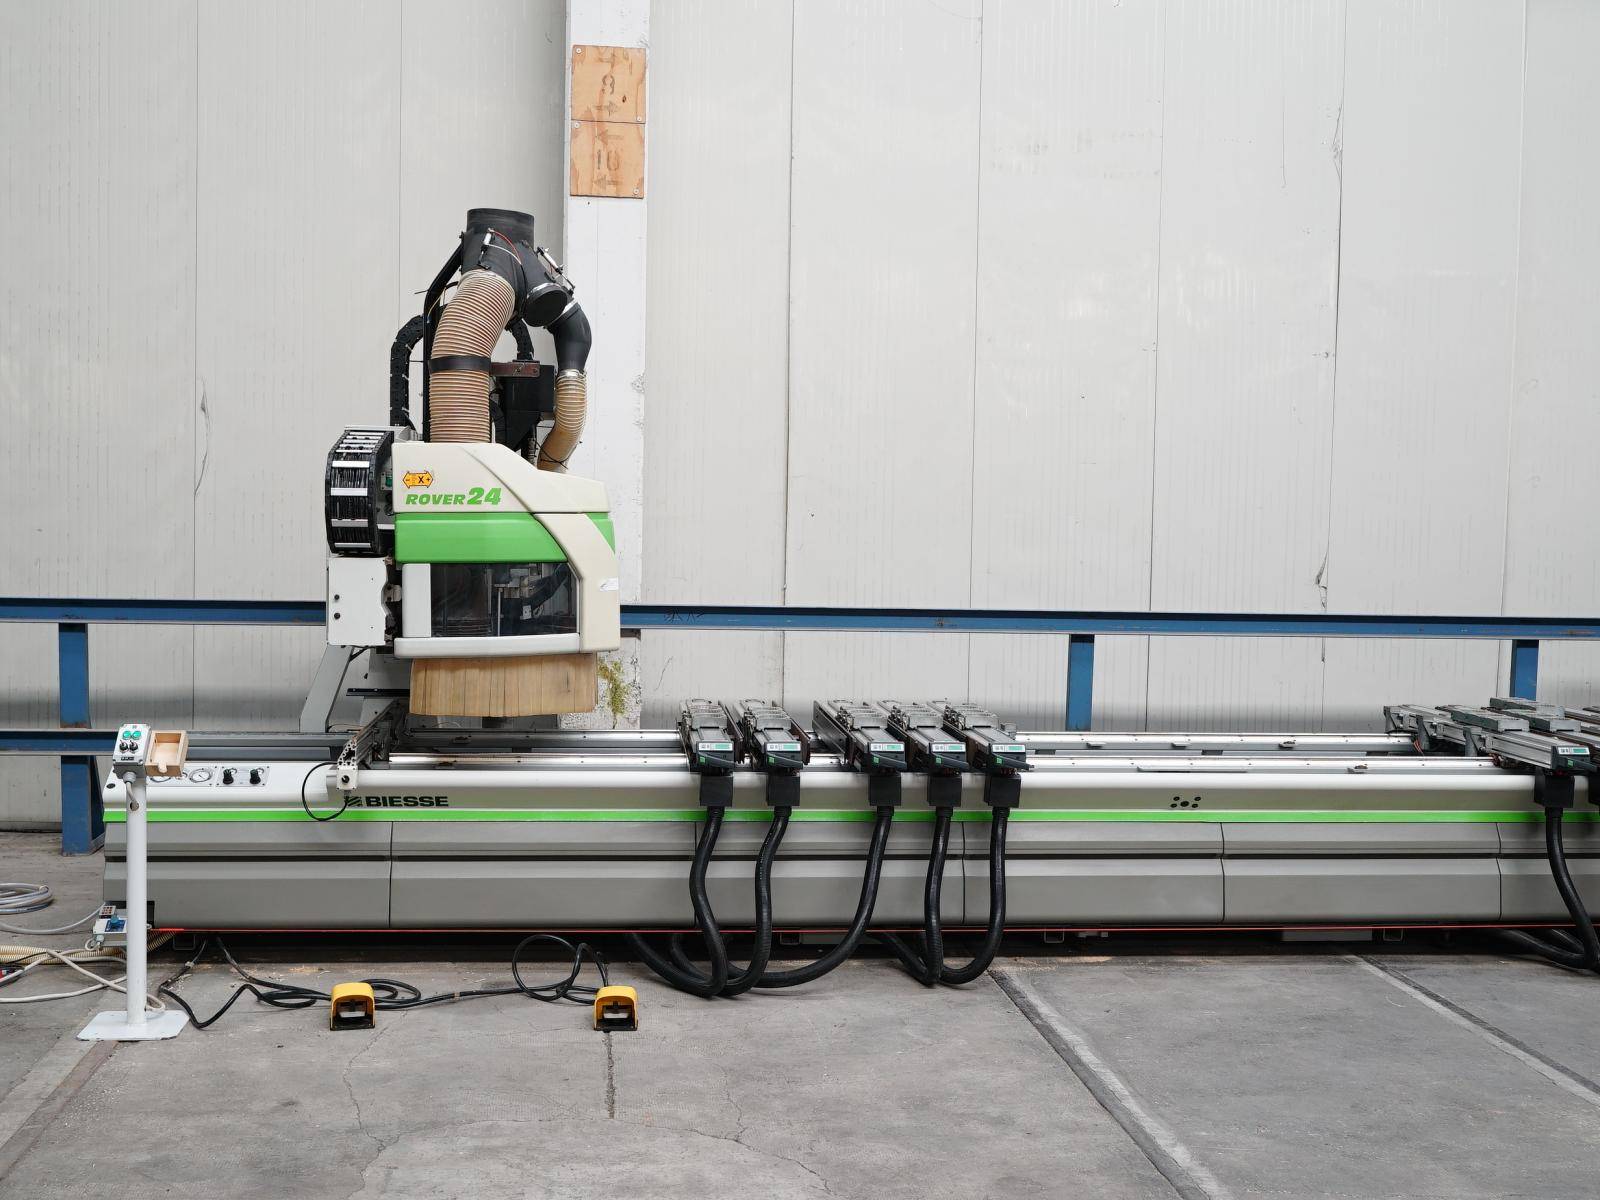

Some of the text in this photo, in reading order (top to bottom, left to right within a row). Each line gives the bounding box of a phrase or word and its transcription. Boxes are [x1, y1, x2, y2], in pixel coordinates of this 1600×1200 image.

[405, 486, 503, 505] ROVER 24
[365, 795, 449, 807] BIESSE
